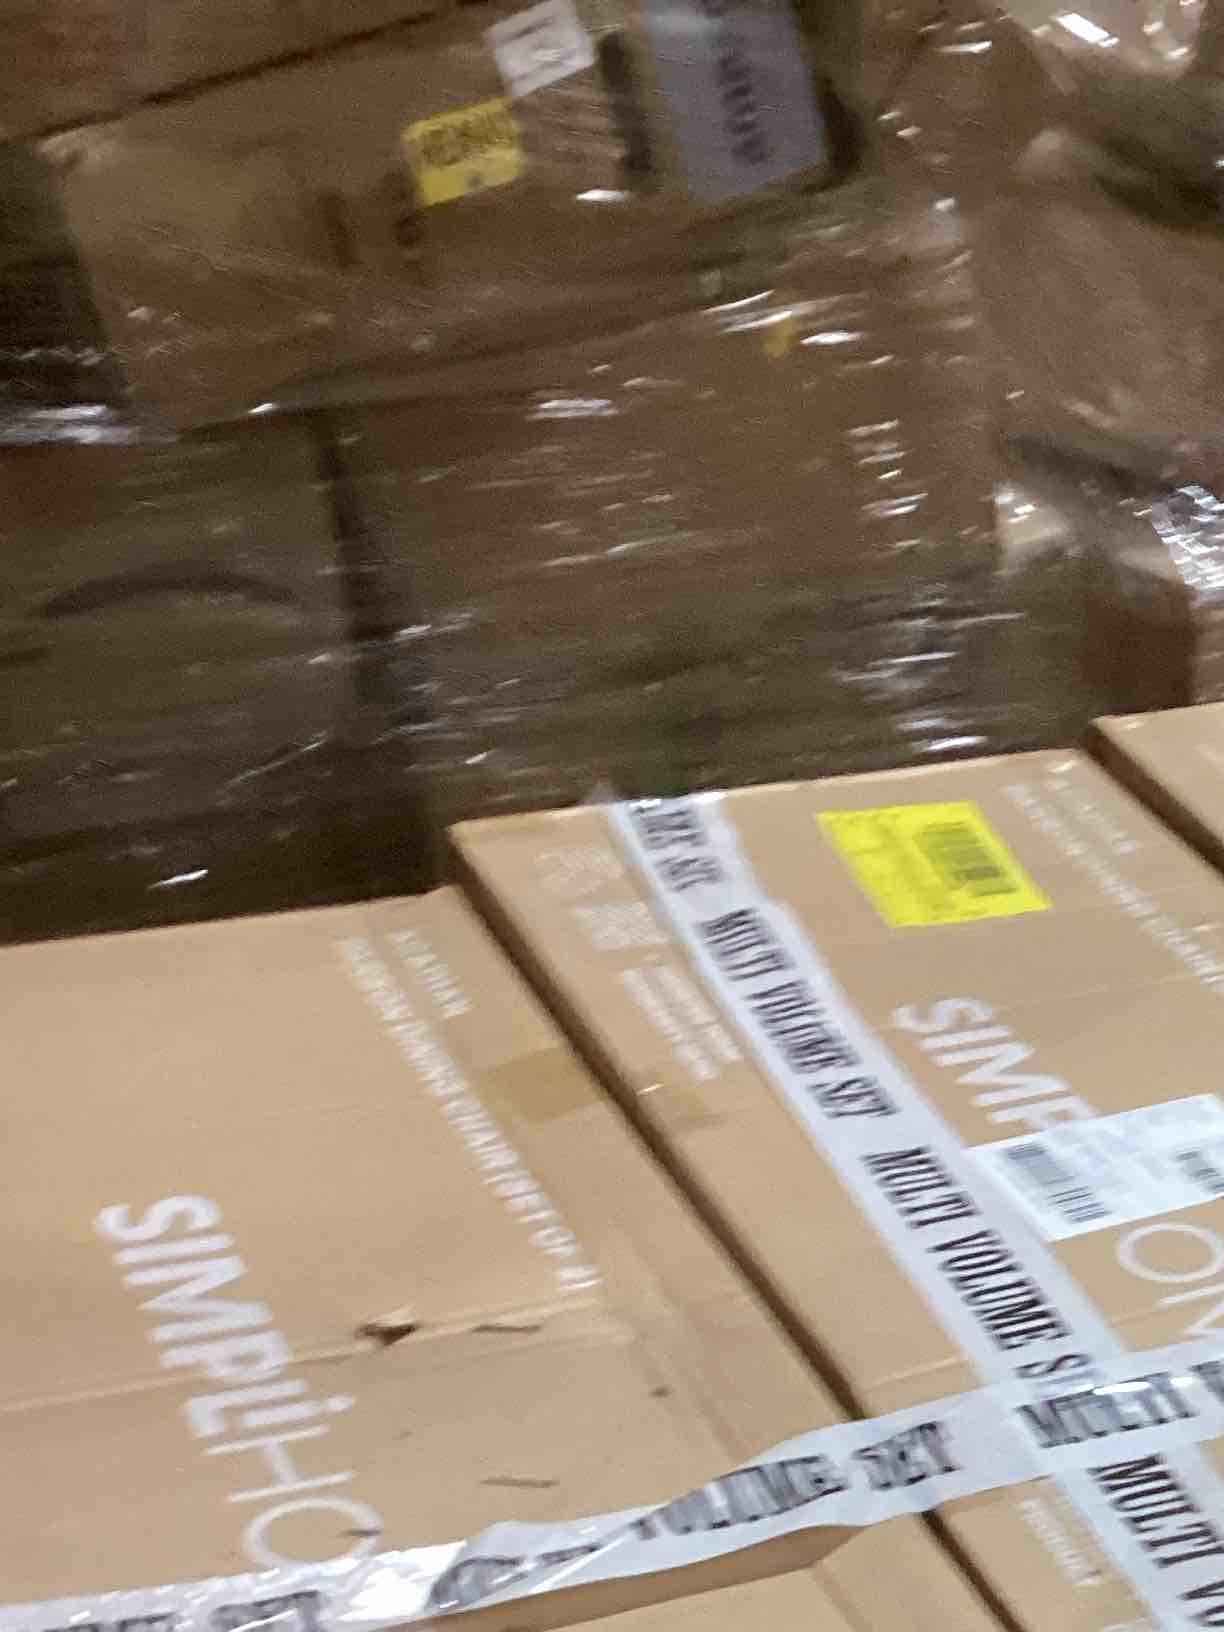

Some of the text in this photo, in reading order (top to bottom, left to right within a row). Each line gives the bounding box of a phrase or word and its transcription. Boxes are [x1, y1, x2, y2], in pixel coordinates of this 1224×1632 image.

[694, 906, 903, 1119] MULTI VOLUME SET
[858, 1144, 984, 1230] MULTI
[924, 1229, 1075, 1352] VOLUME
